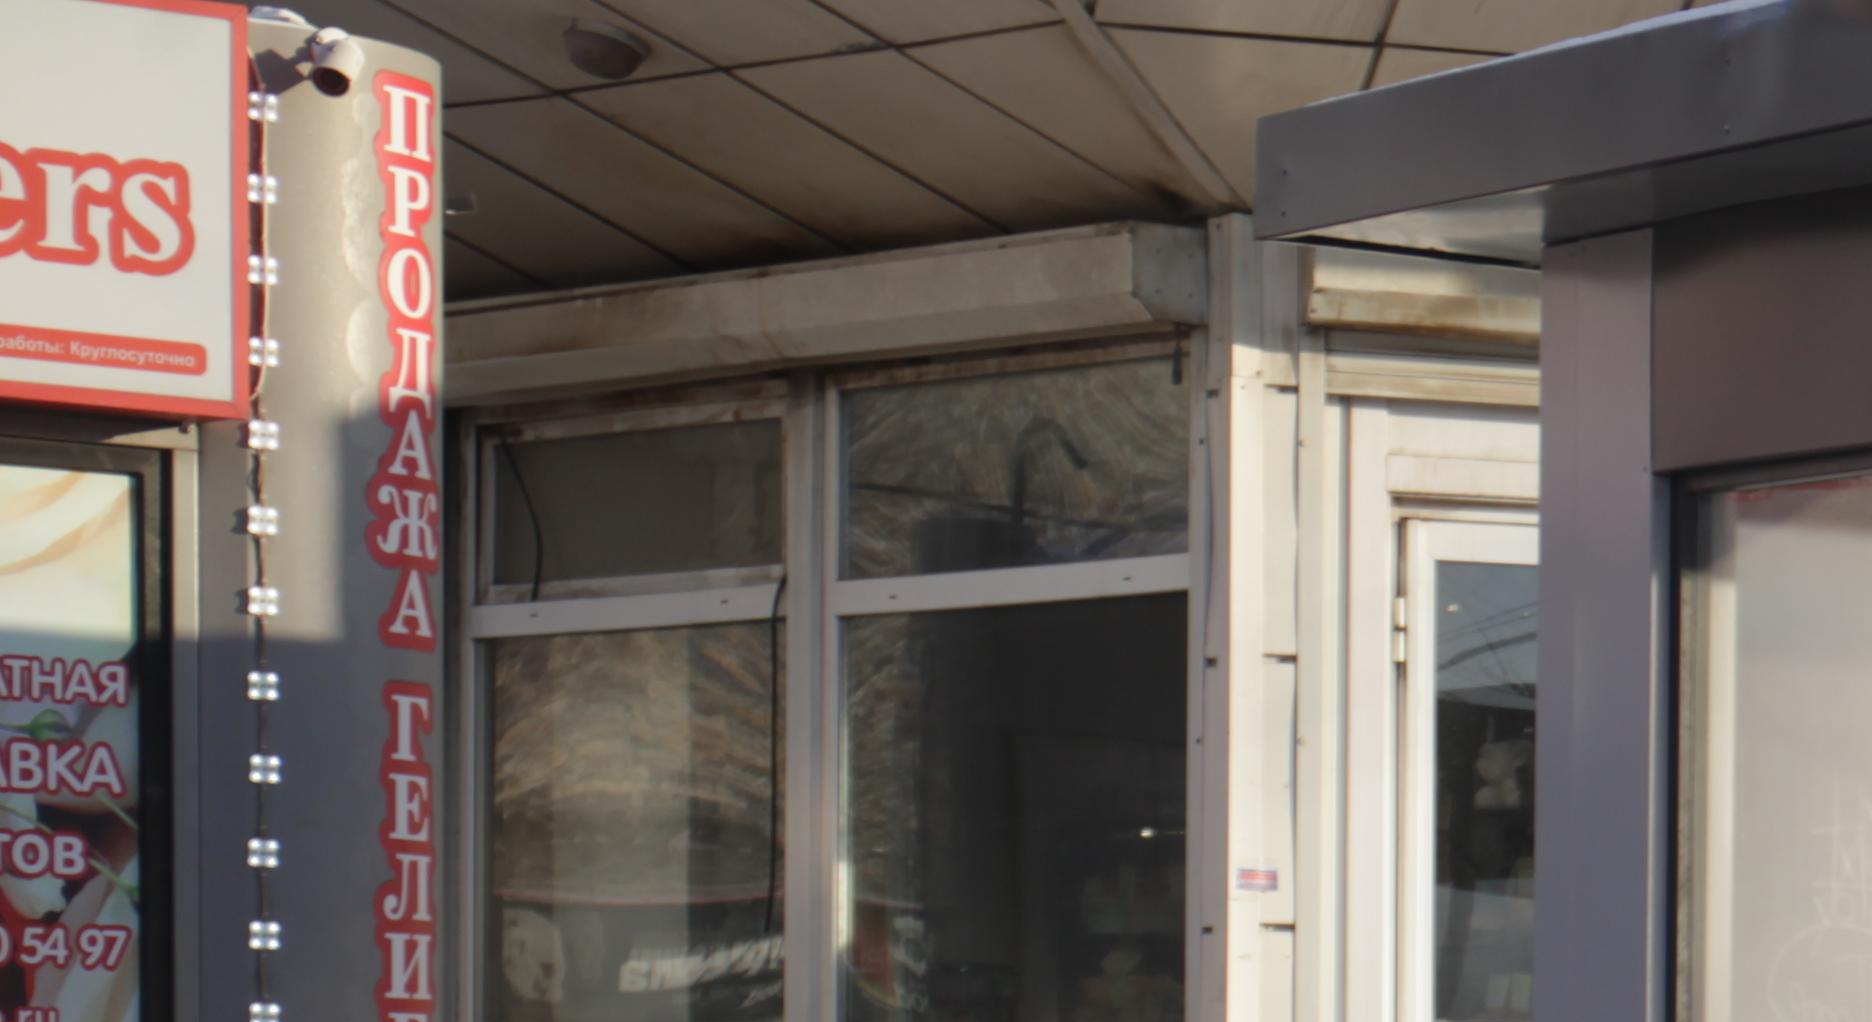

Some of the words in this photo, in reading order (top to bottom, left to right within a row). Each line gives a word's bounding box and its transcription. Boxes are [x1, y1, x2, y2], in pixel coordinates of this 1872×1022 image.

[69, 340, 197, 368] Круглосуточно
[376, 83, 440, 640] ПРОДАЖА
[0, 659, 126, 704] ТНАЯ
[0, 742, 122, 794] ВКА
[20, 926, 68, 965] 54
[80, 927, 128, 967] 97
